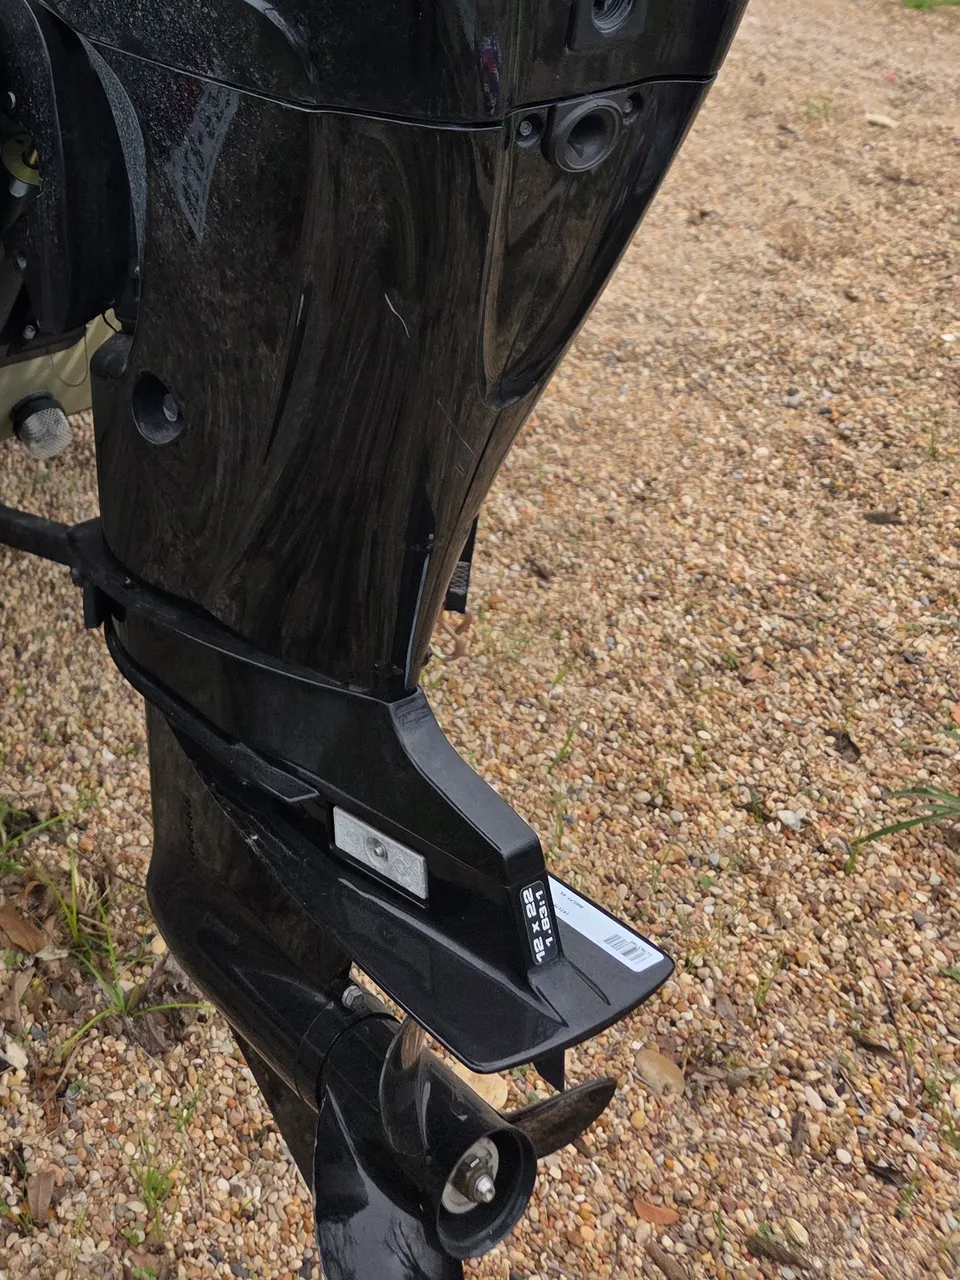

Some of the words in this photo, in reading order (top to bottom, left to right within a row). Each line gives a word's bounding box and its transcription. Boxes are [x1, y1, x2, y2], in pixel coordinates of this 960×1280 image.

[522, 887, 537, 918] 22
[535, 890, 553, 947] 1.83:1
[533, 936, 546, 963] 12
